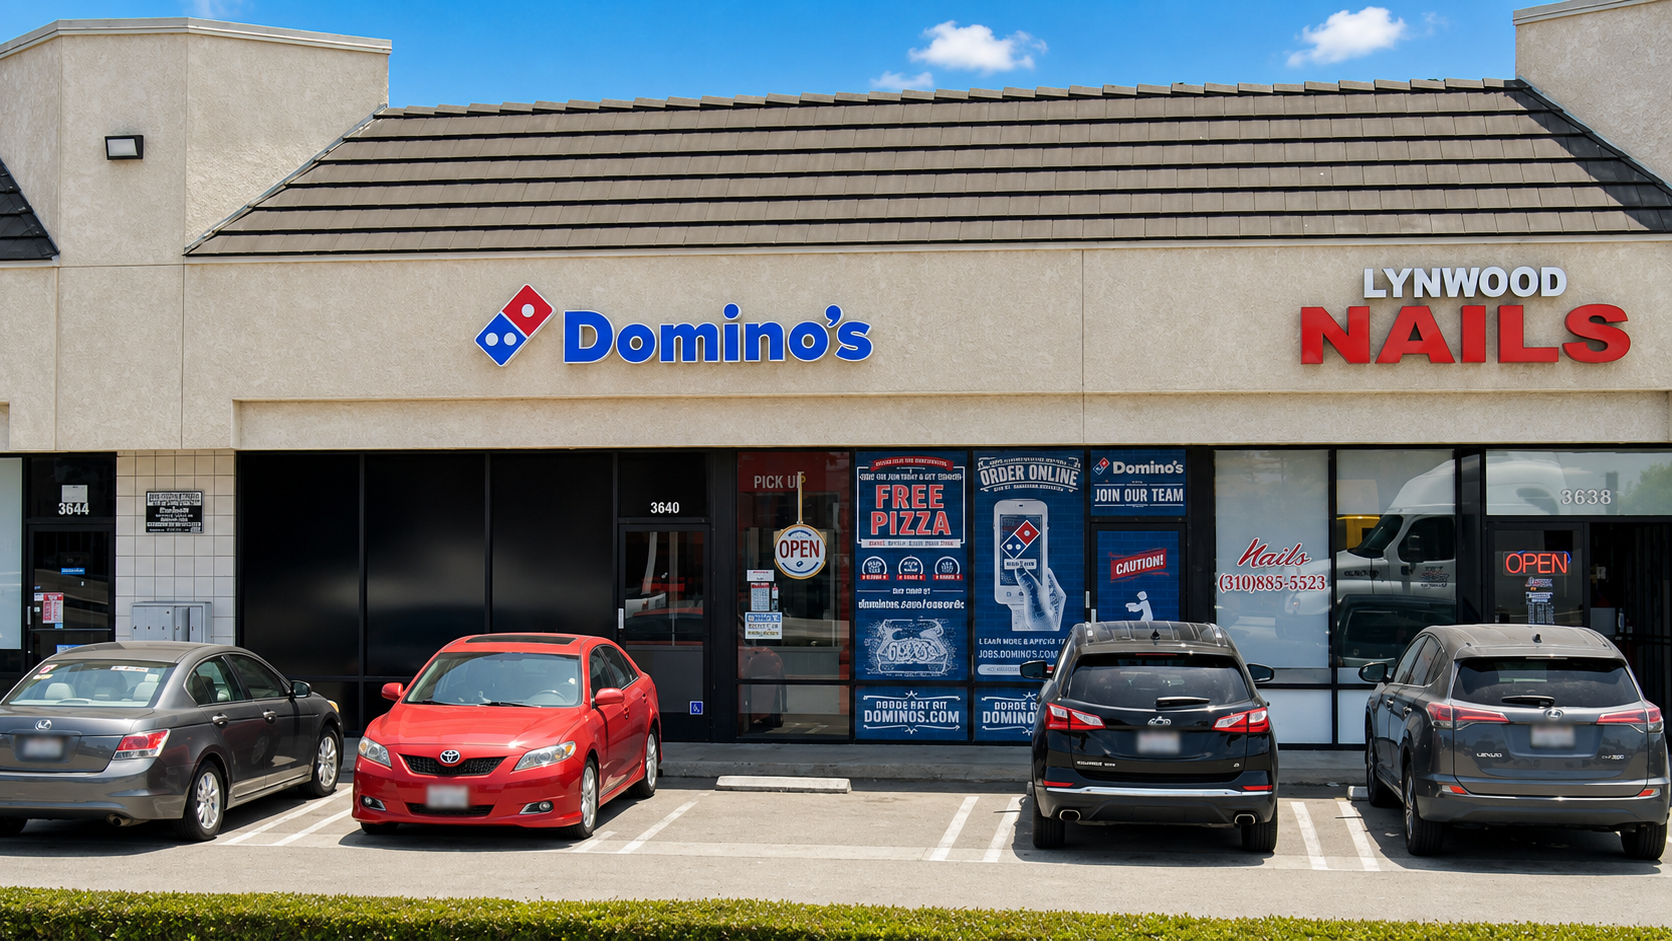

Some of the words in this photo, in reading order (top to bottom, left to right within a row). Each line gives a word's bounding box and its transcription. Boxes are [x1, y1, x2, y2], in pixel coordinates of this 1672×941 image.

[1363, 266, 1567, 299] LYNWOOD
[562, 303, 873, 365] Domino's
[1300, 303, 1632, 365] NAILS
[980, 465, 1025, 486] ORDER
[1029, 464, 1079, 487] ONLINE
[1113, 460, 1184, 475] Domino's
[754, 475, 784, 489] PICK
[875, 484, 945, 509] FREE
[1095, 488, 1120, 502] JOIN
[1124, 488, 1148, 502] OUR
[1151, 488, 1184, 502] TEAM
[1561, 488, 1612, 506] 3638
[58, 502, 89, 515] 3644
[650, 502, 680, 514] 3640
[870, 511, 952, 536] PIZZA
[779, 540, 820, 559] OPEN
[1237, 537, 1312, 569] Nails
[1115, 554, 1164, 575] CAUTION!
[1505, 553, 1568, 574] OPEN
[1219, 573, 1328, 594] (310)885-5523
[864, 709, 960, 723] DOMINOS.COM
[982, 711, 1035, 724] DOMINO
